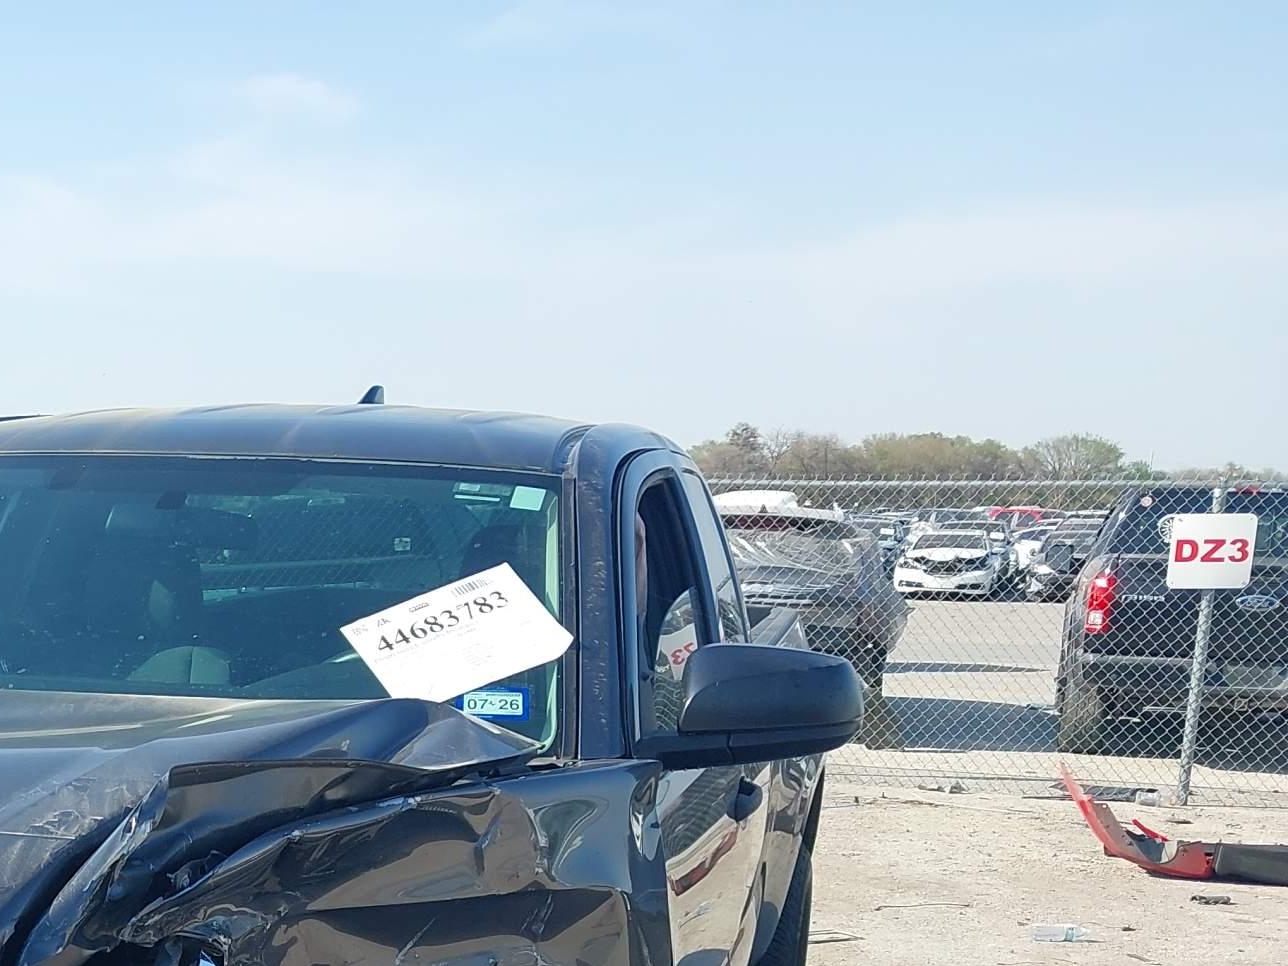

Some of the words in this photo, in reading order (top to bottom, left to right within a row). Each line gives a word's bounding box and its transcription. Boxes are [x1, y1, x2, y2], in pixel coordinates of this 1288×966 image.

[1174, 538, 1249, 563] DZ3
[377, 590, 510, 651] 44683783
[467, 698, 488, 710] 07
[498, 698, 520, 710] 26
